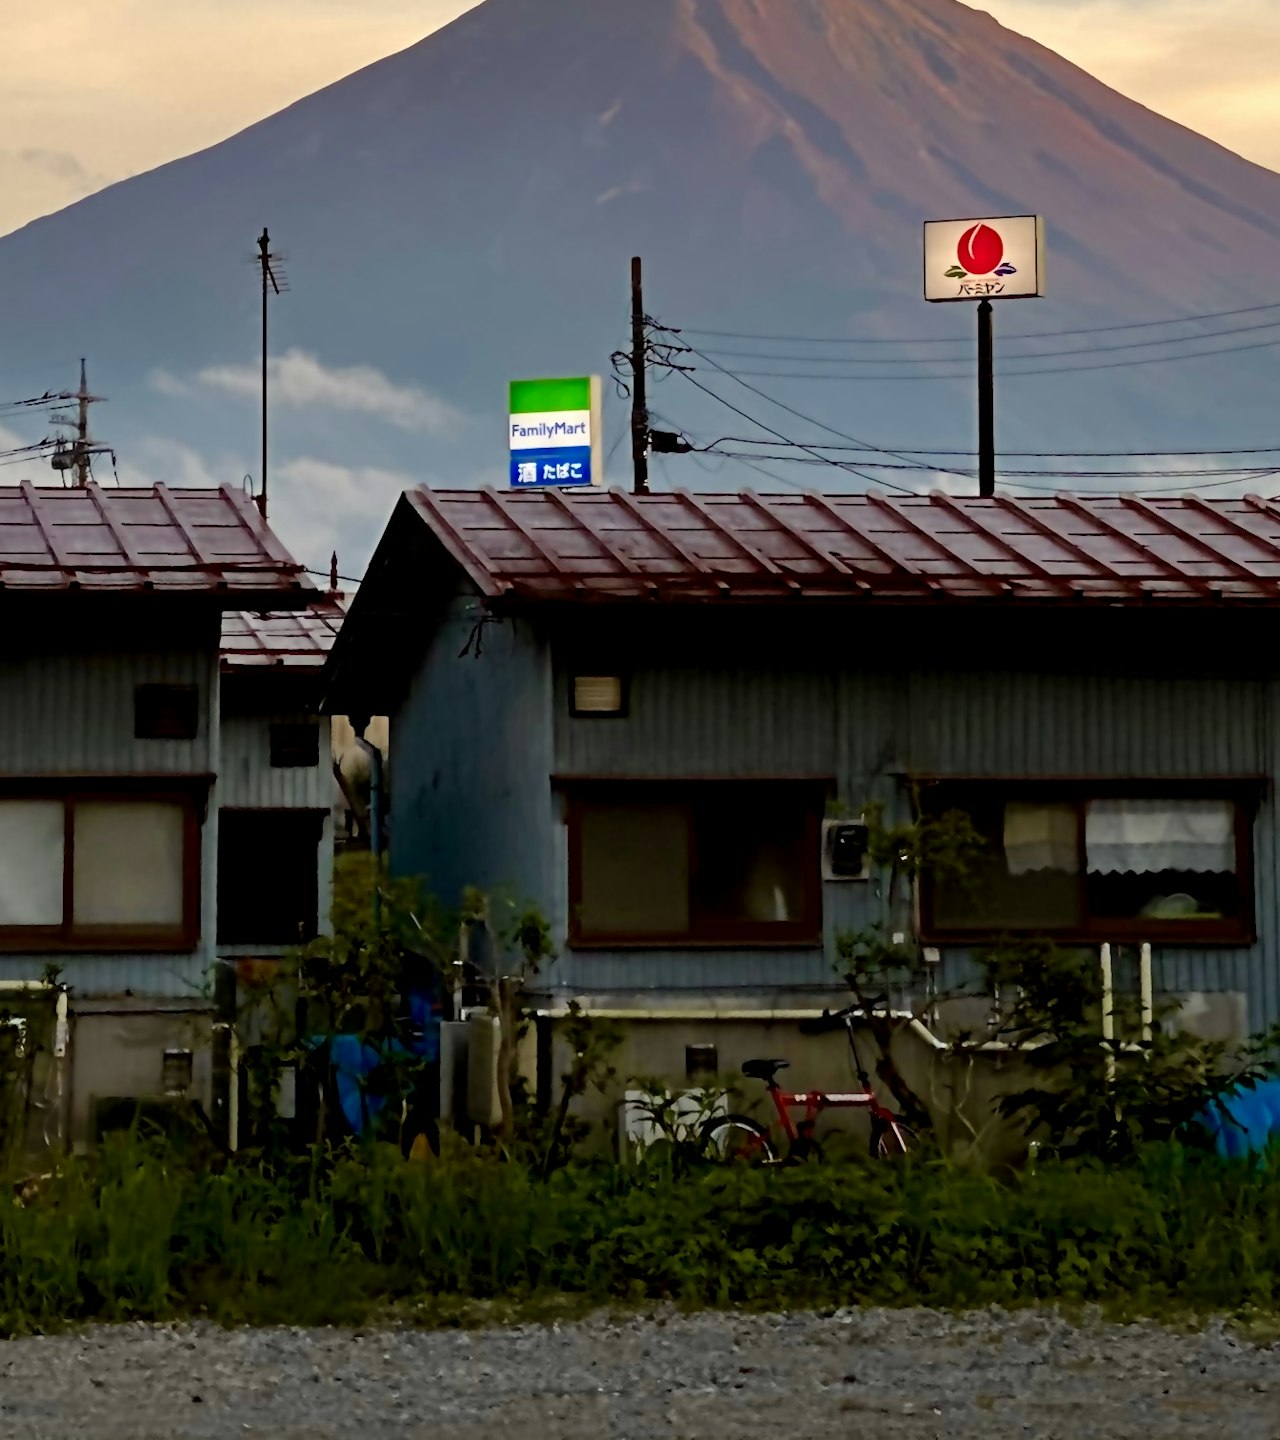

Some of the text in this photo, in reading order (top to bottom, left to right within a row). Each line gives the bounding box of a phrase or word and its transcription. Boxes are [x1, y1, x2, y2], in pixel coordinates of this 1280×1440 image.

[957, 282, 1006, 295] バーミヤン
[511, 422, 586, 438] FamilyMart
[518, 462, 583, 483] 酒 たばこ
